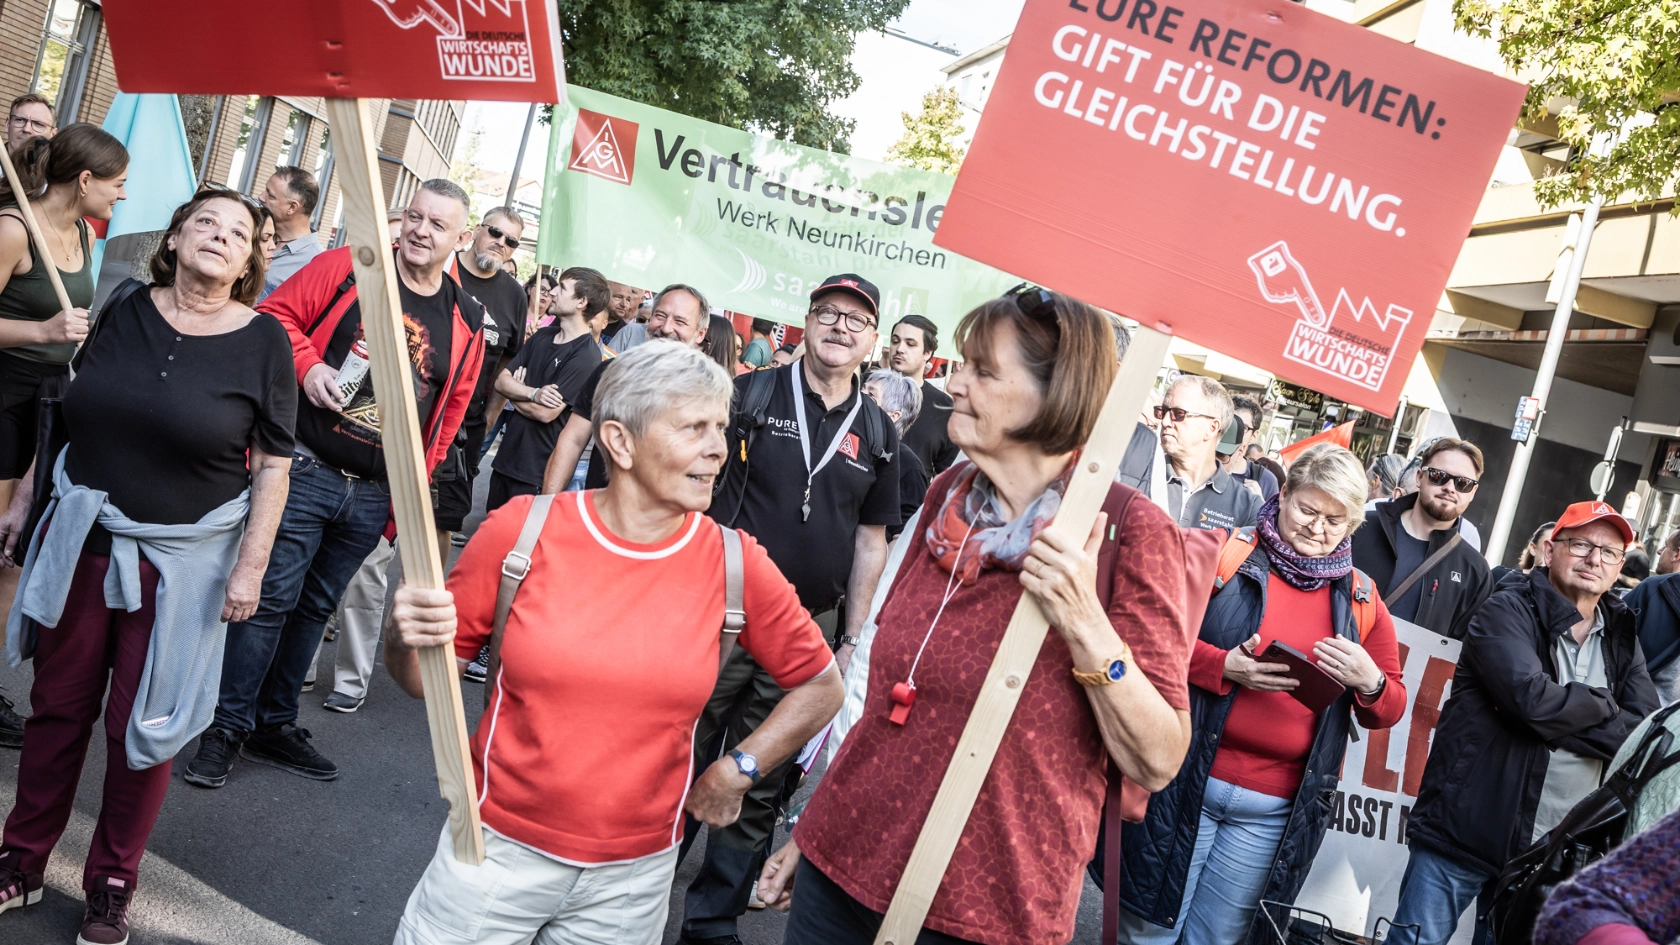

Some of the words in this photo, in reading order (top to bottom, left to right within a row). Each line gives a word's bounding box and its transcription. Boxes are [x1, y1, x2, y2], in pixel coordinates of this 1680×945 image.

[441, 40, 528, 55] WIRTSCHAFTS
[466, 31, 479, 40] DIE
[482, 31, 525, 41] DEUTSCHE
[443, 54, 531, 77] WUNDE
[1189, 18, 1447, 140] REFORMEN:
[1052, 24, 1152, 84] GIFT
[1153, 59, 1242, 121] FÜR
[1247, 93, 1327, 150] DIE
[1034, 71, 1406, 237] GLEICHSTELLUNG.
[717, 197, 779, 234] Werk
[787, 216, 946, 269] Neunkirchen
[771, 297, 787, 310] We
[789, 303, 806, 314] are
[1298, 324, 1387, 366] WIRTSCHAFTS
[1329, 327, 1344, 338] DIE
[1345, 332, 1391, 355] DEUTSCHE
[1293, 336, 1382, 386] WUNDE
[768, 417, 798, 430] PURE
